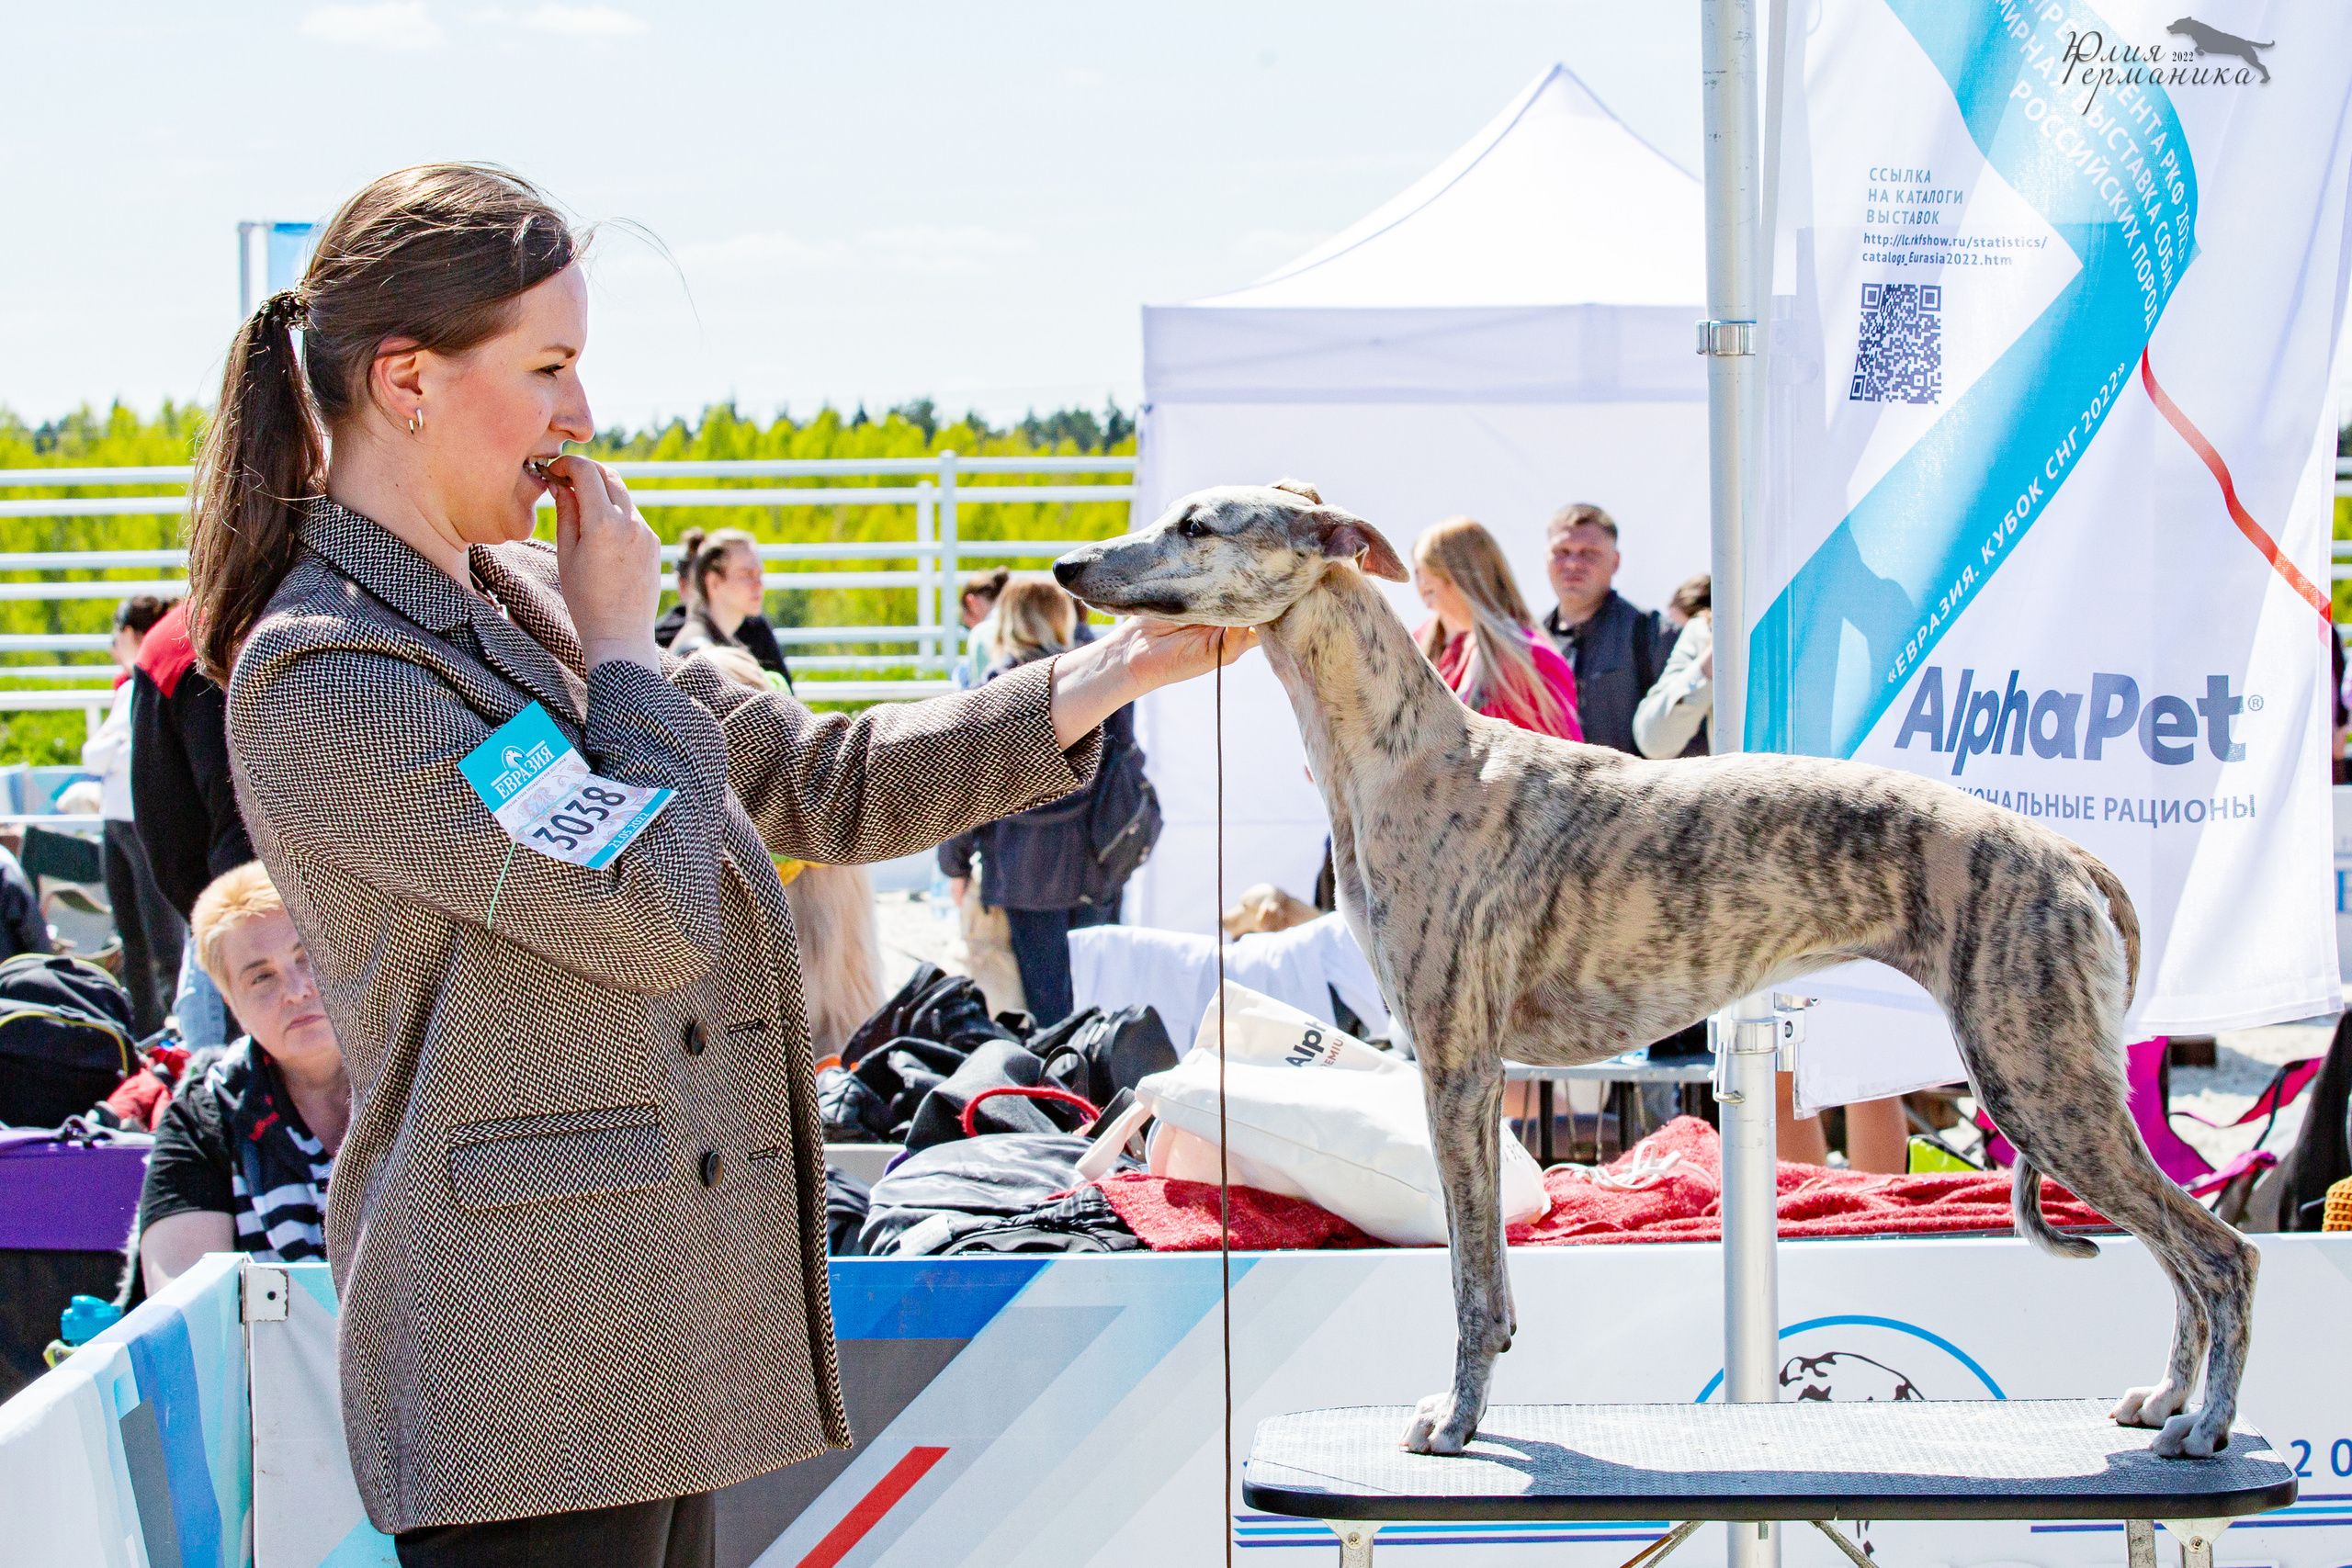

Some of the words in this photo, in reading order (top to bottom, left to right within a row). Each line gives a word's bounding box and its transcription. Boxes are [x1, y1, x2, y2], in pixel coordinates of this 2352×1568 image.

[1868, 188, 1889, 203] НА
[1895, 189, 1963, 205] КАТАЛОГИ
[1869, 167, 1931, 184] ССЫЛКА
[2072, 89, 2162, 226] ВЫСТАВКА
[2154, 220, 2173, 299] СОБАК
[2160, 148, 2185, 205] РКФ
[1866, 209, 1939, 225] ВЫСТАВОК
[2009, 79, 2141, 249] РОССИЙСКИХ
[2131, 242, 2158, 333] ПОРОД
[1863, 232, 2048, 249] http://lc.rkfshow.ru/statistics/
[1888, 564, 1979, 683] «ЕВРАЗИЯ.
[1981, 476, 2043, 565] КУБОК
[2045, 426, 2077, 479] СНГ
[2081, 361, 2126, 434] 2022»
[494, 744, 555, 799] ЕВРАЗИЯ
[532, 786, 627, 851] 3038
[608, 812, 650, 848] 21.05.2022
[1956, 786, 2095, 820] НАЛЬНЫЕ
[2104, 794, 2256, 829] РАЦИОНЫ
